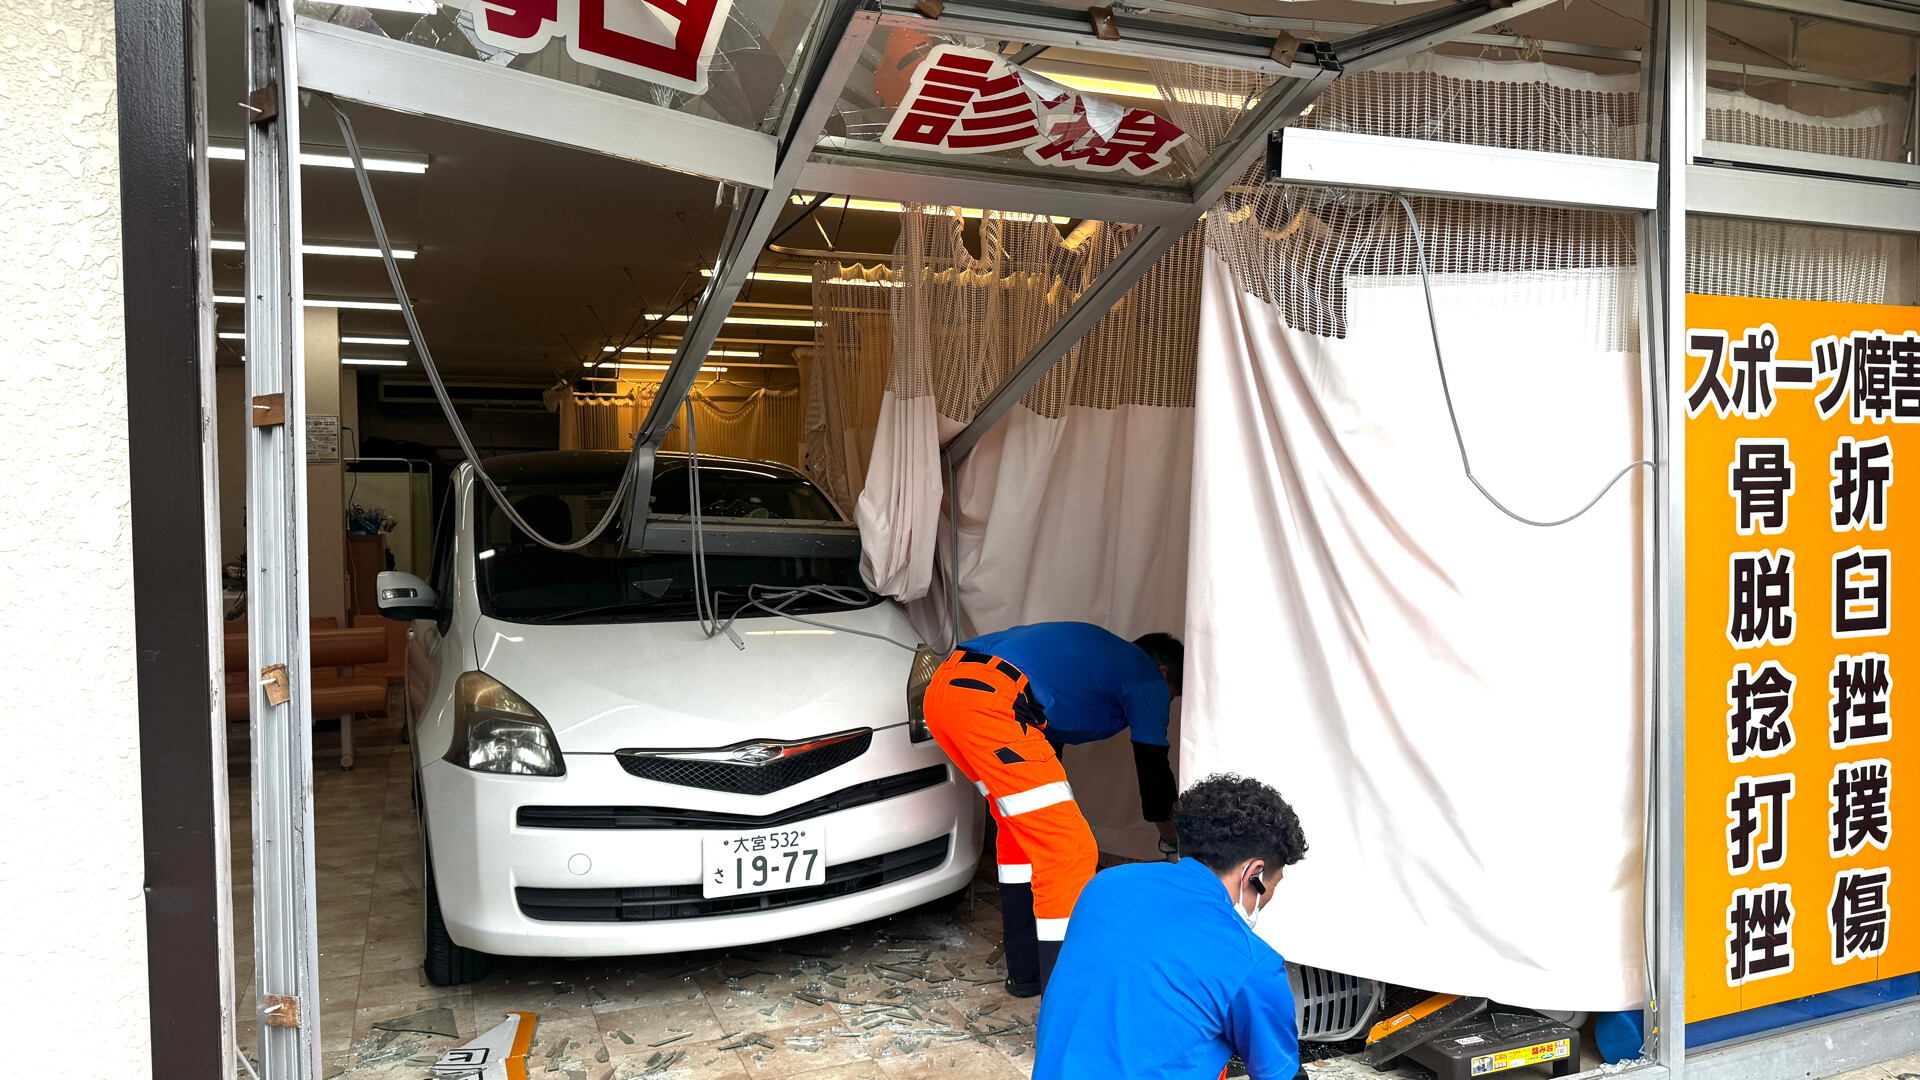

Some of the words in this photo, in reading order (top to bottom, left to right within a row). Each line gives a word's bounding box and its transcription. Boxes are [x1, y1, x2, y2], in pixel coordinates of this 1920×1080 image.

[1688, 330, 1920, 419] スポーツ障害
[733, 834, 767, 853] 大宮
[770, 831, 799, 849] 532
[714, 868, 724, 884] さ
[736, 849, 819, 889] 19-77
